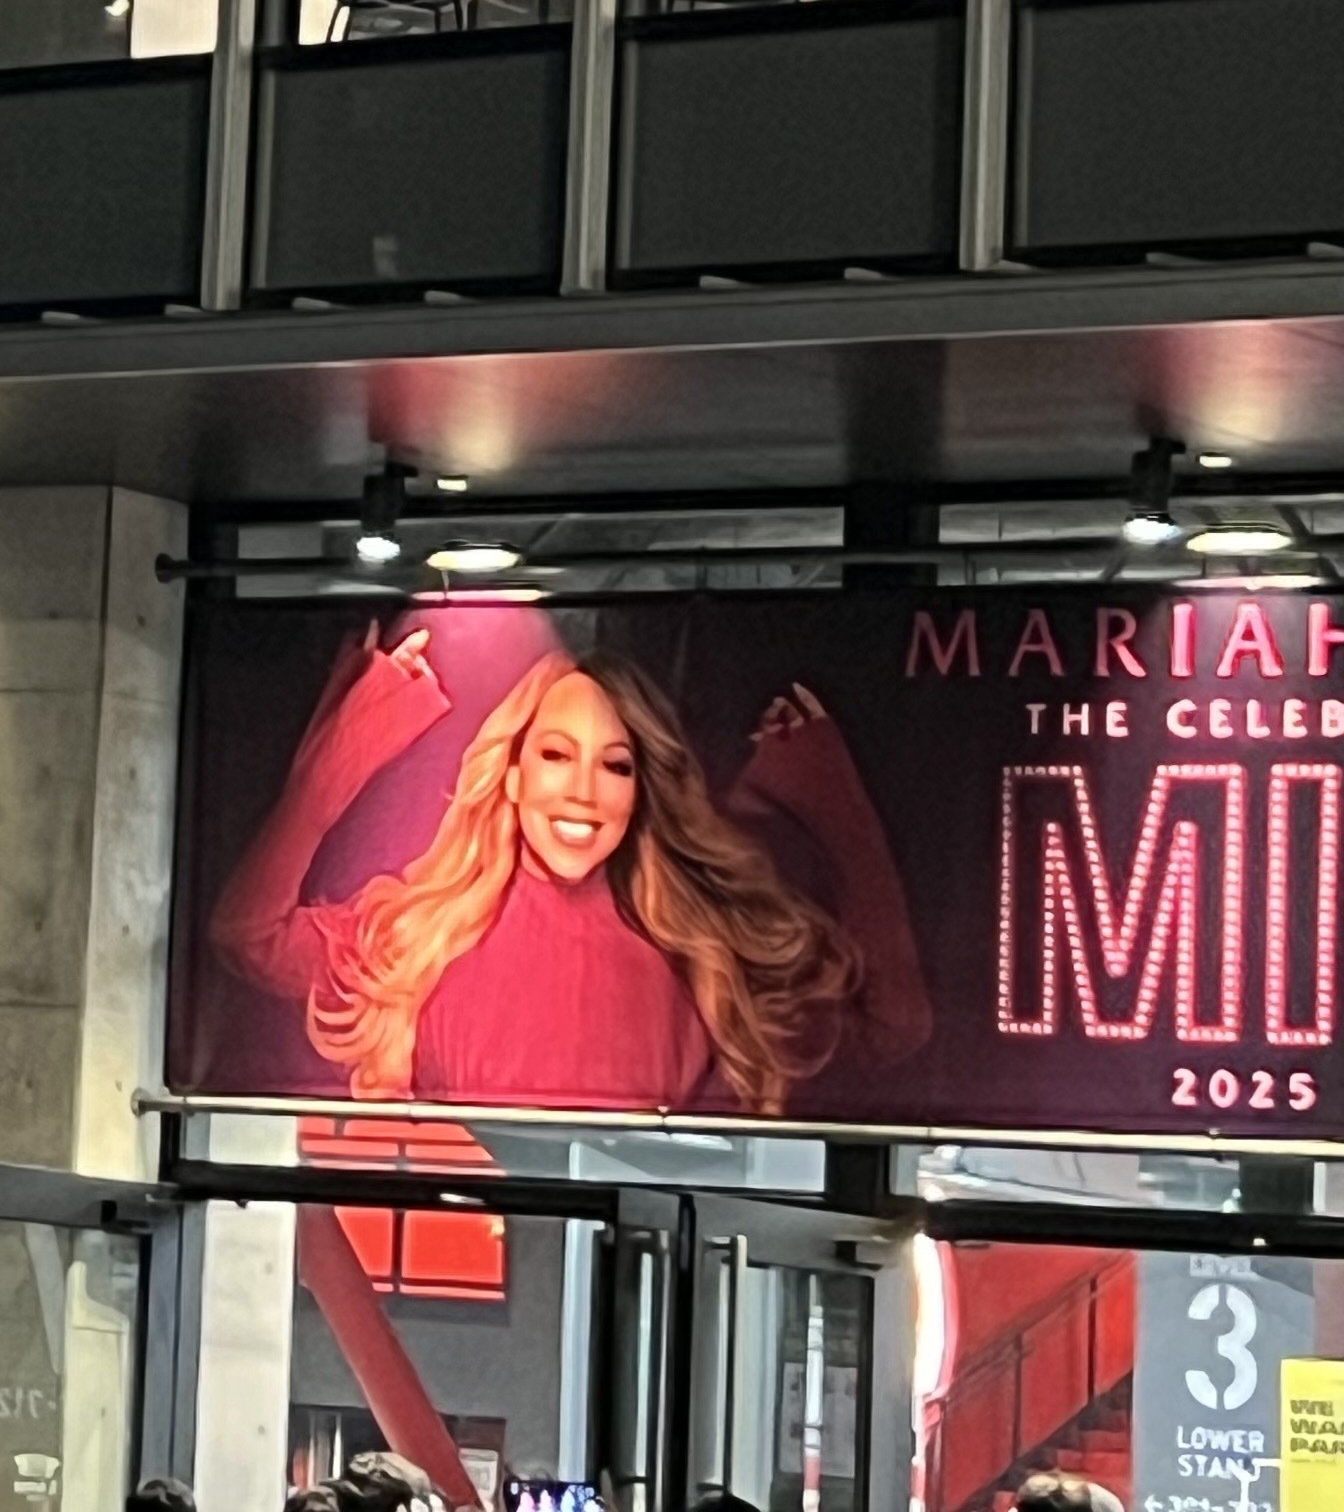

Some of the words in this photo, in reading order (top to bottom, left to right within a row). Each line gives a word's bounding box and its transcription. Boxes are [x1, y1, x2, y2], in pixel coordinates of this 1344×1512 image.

[905, 601, 1344, 679] MARIAH
[1025, 700, 1130, 738] THE
[1171, 1069, 1318, 1111] 2025
[1185, 1284, 1258, 1410] 3
[1176, 1425, 1265, 1454] LOWER
[1177, 1453, 1260, 1479] STAN
